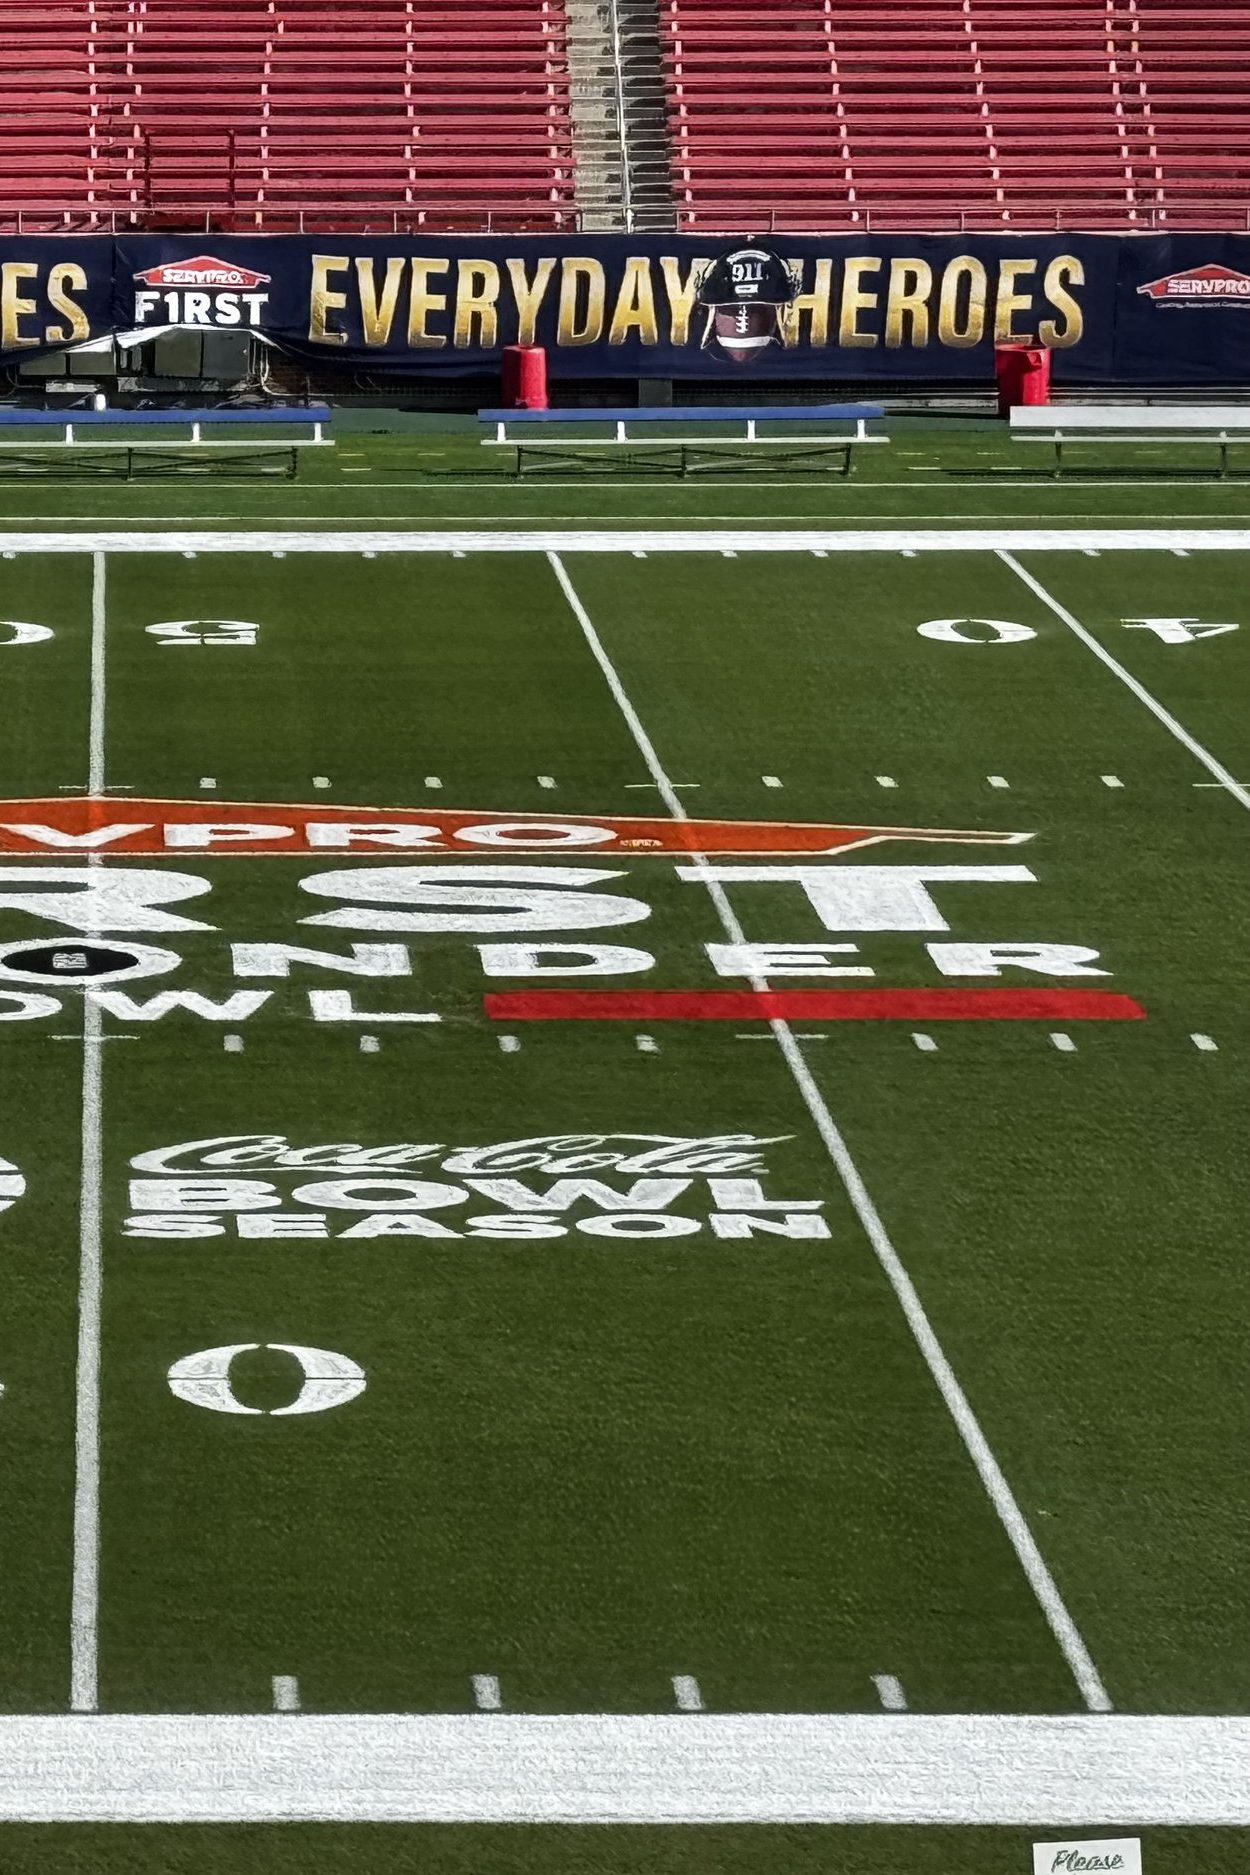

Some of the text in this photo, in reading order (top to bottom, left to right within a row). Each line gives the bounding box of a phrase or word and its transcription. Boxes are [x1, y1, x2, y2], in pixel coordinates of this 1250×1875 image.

[732, 263, 763, 283] 911
[1167, 279, 1250, 294] SERVPRO
[310, 254, 1086, 349] EVERYDAY HEROES
[129, 1179, 825, 1211] BOWL
[122, 1213, 832, 1239] SEASON
[1051, 1850, 1125, 1873] Please
